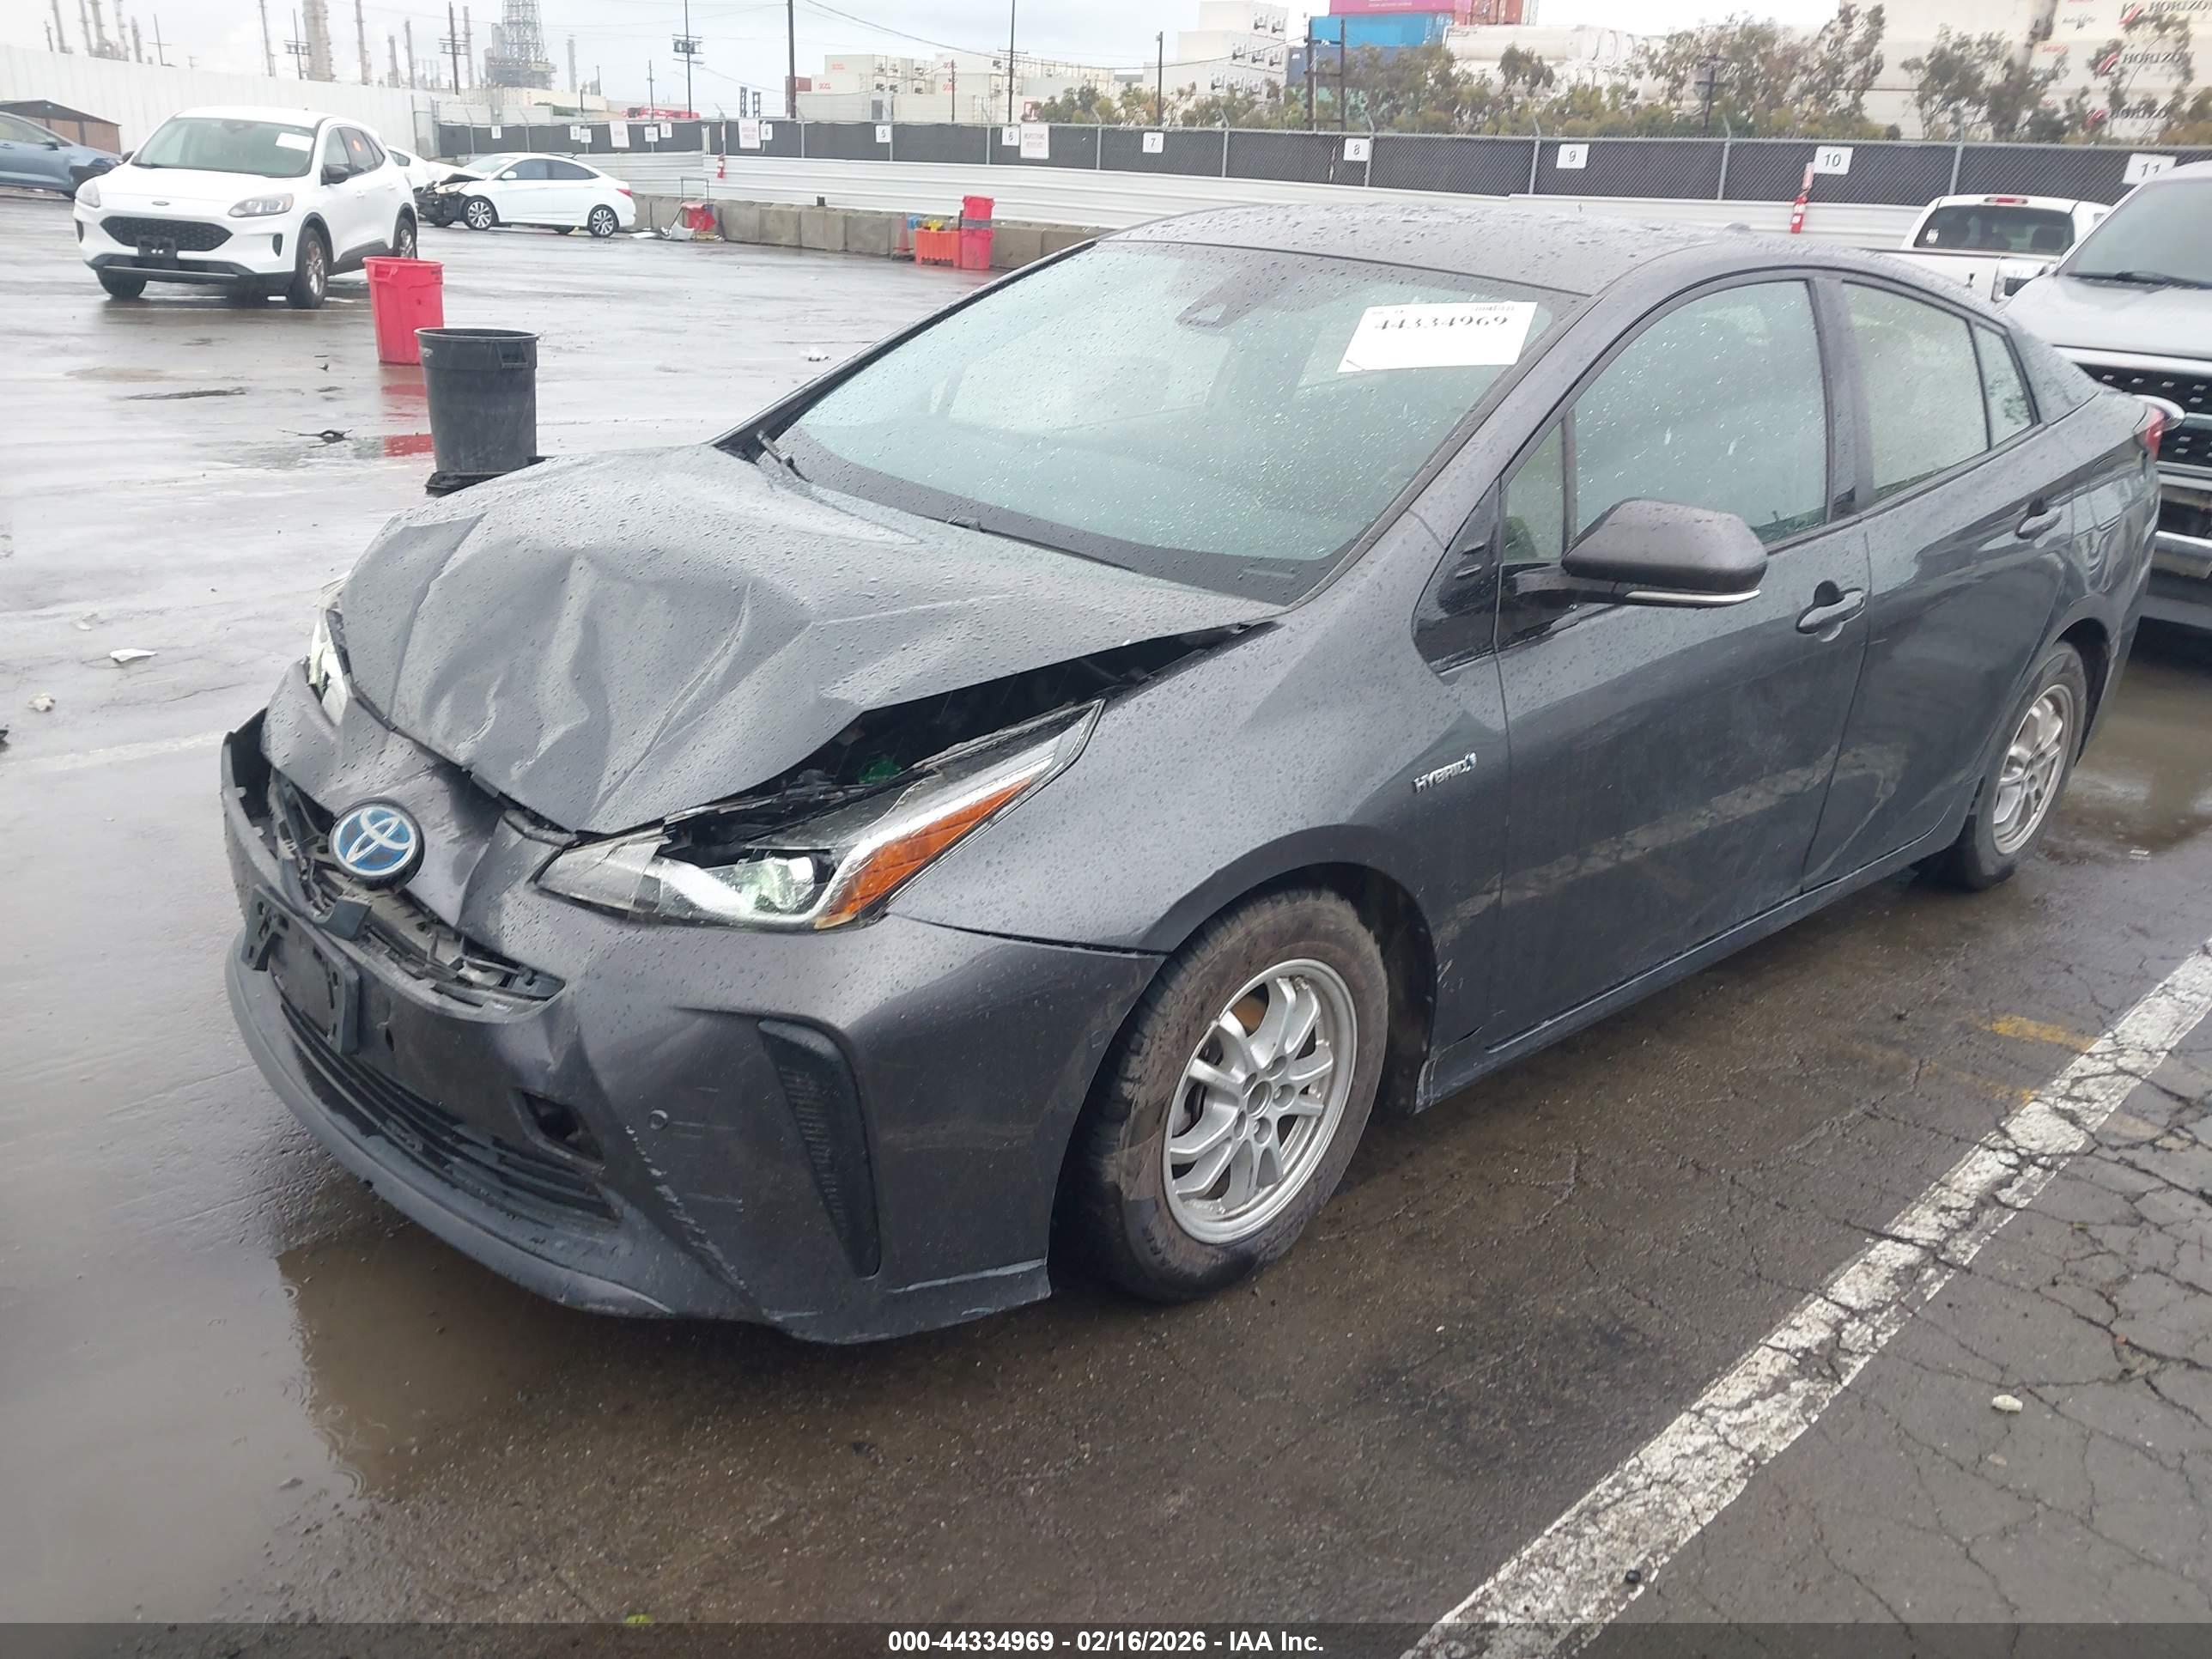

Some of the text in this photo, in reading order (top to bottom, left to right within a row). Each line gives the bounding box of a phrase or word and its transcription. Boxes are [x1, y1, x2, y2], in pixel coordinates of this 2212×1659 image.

[2148, 0, 2212, 12] HORIZO
[1008, 131, 1014, 142] 6
[1150, 137, 1156, 148] 7
[1353, 143, 1360, 155] 8
[1568, 150, 1577, 162] 9
[1824, 153, 1842, 167] 10
[2141, 161, 2161, 178] 11
[1374, 315, 1509, 331] 44334969
[1412, 756, 1471, 794] HYBRID
